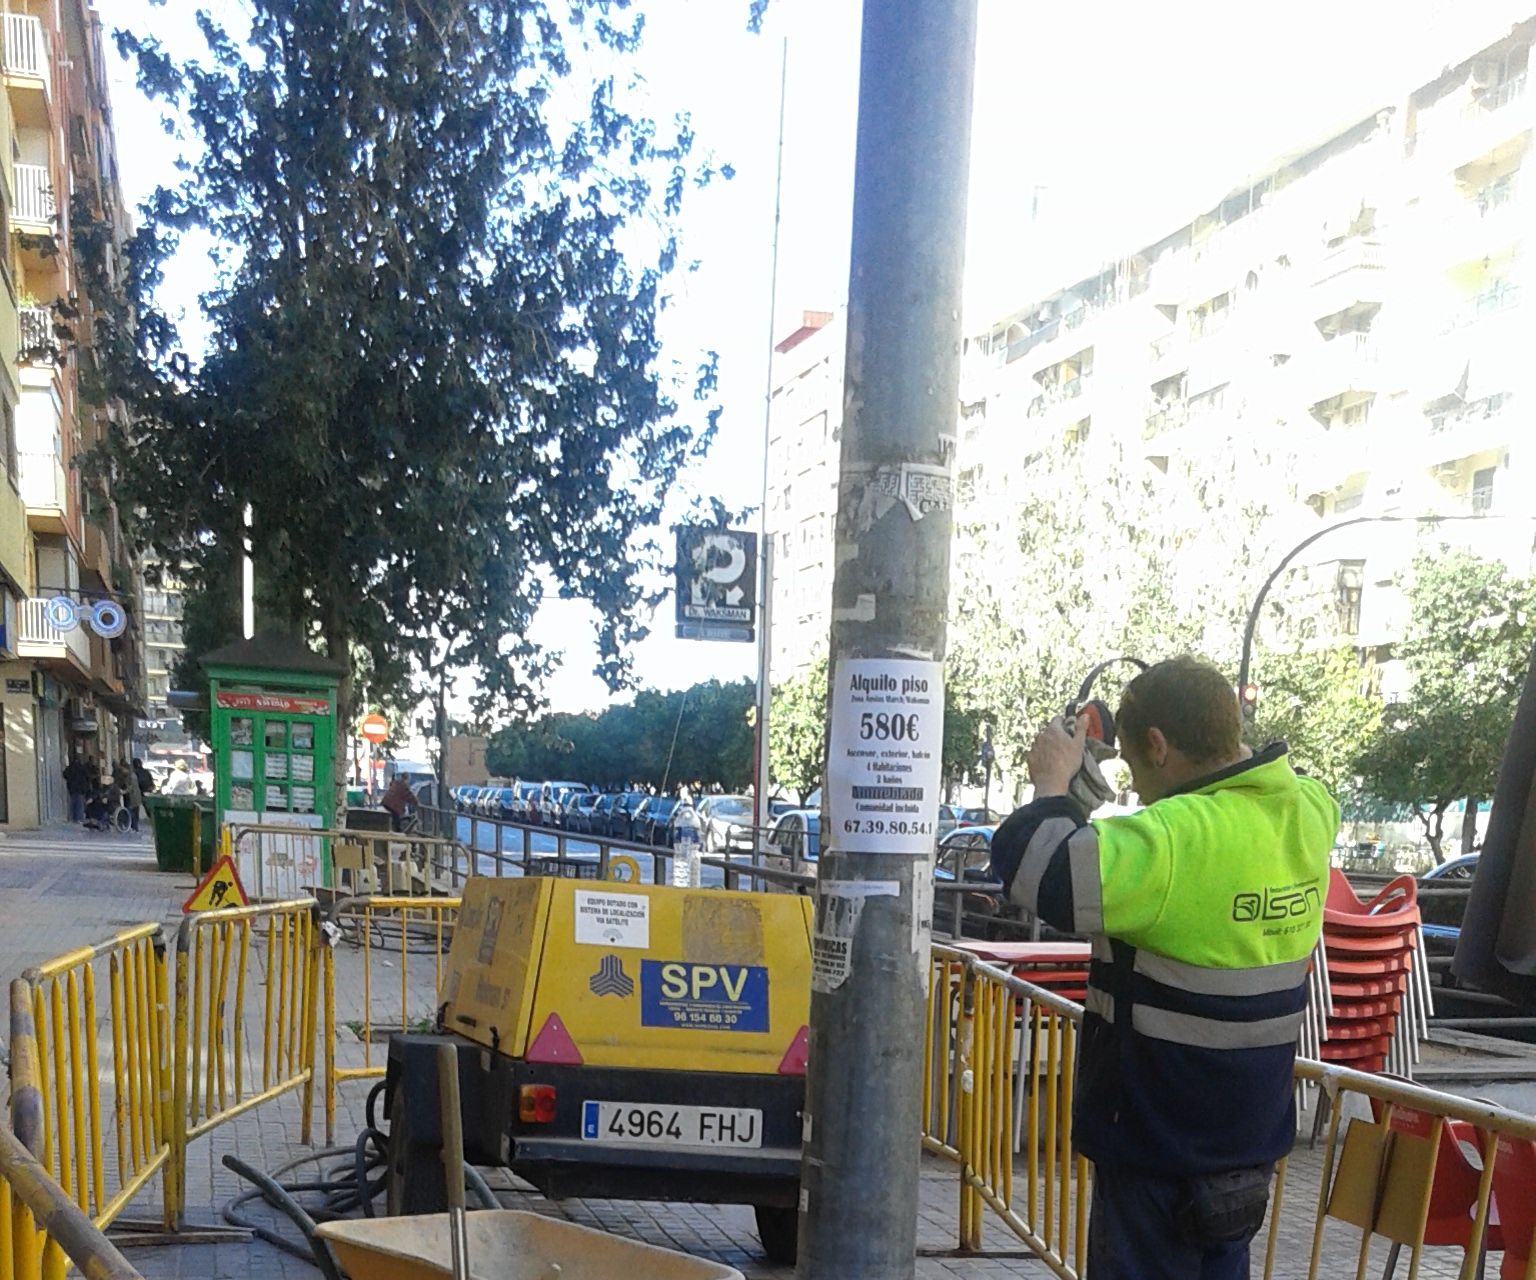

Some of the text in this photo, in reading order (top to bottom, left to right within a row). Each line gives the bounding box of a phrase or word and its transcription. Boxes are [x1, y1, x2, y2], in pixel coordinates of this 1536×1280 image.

[850, 674, 928, 695] Alquilo piso
[860, 712, 919, 741] 580€
[661, 964, 748, 1002] SPV
[608, 1108, 754, 1143] 4964 FHJ
